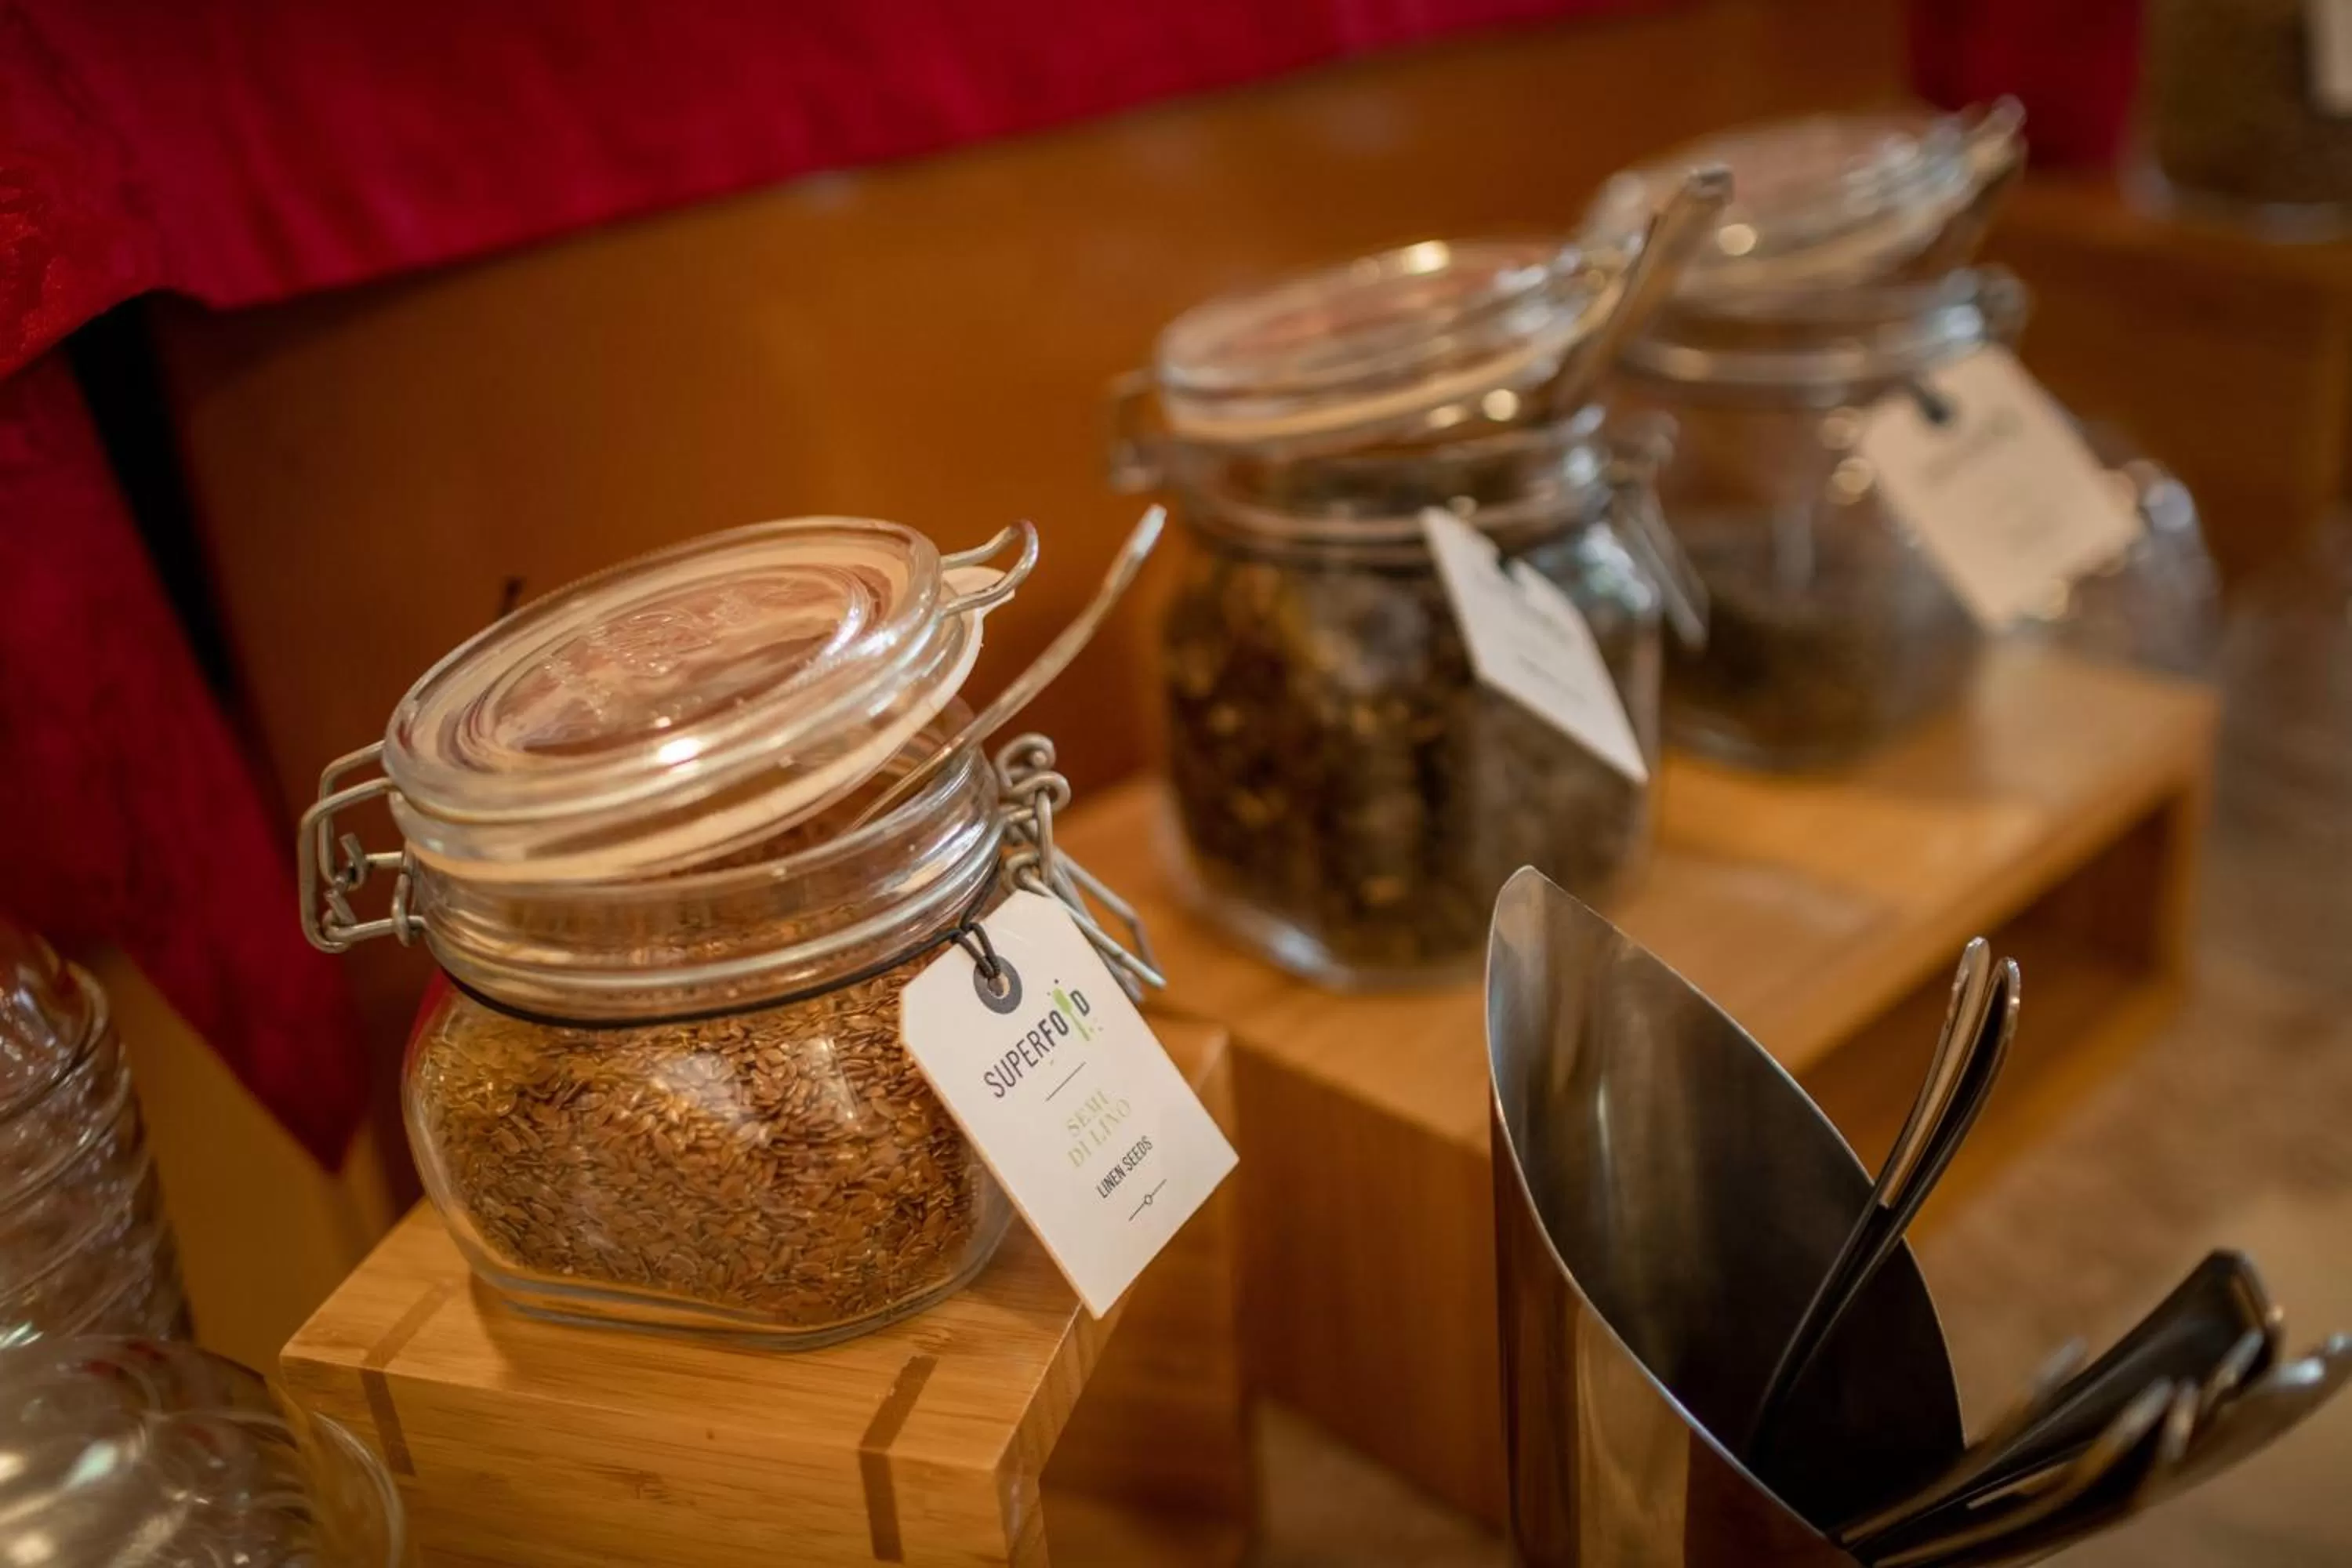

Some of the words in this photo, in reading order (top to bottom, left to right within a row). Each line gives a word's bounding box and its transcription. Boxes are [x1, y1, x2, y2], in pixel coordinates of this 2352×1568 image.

[984, 988, 1091, 1098] SUPERFOD
[1066, 1090, 1109, 1137] SEMI
[1067, 1140, 1092, 1167] DI
[1089, 1098, 1131, 1146] LINO
[1096, 1163, 1127, 1199] LINEN
[1122, 1134, 1153, 1171] SEEDS
